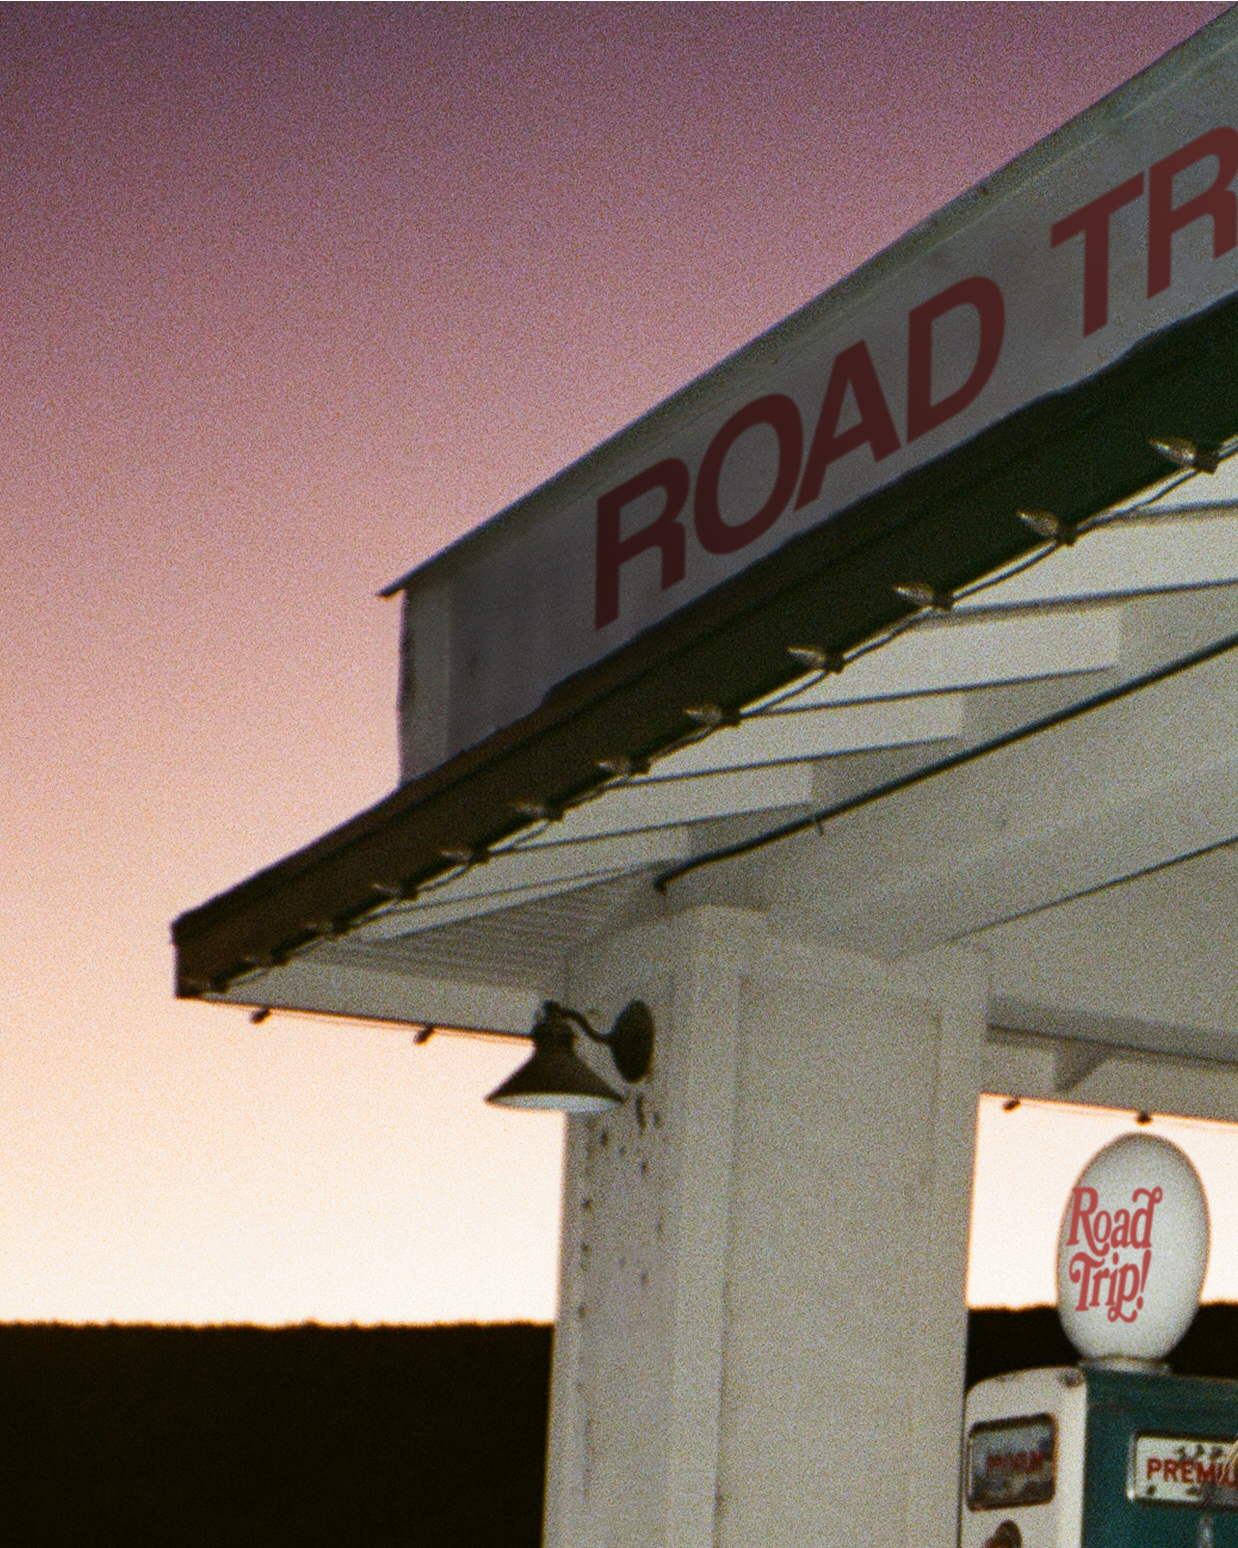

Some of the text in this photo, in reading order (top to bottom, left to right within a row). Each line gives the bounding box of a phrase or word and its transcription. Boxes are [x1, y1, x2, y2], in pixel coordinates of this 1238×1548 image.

[593, 276, 1005, 632] ROAD
[1065, 1186, 1163, 1257] Road
[1068, 1248, 1152, 1323] Trip!
